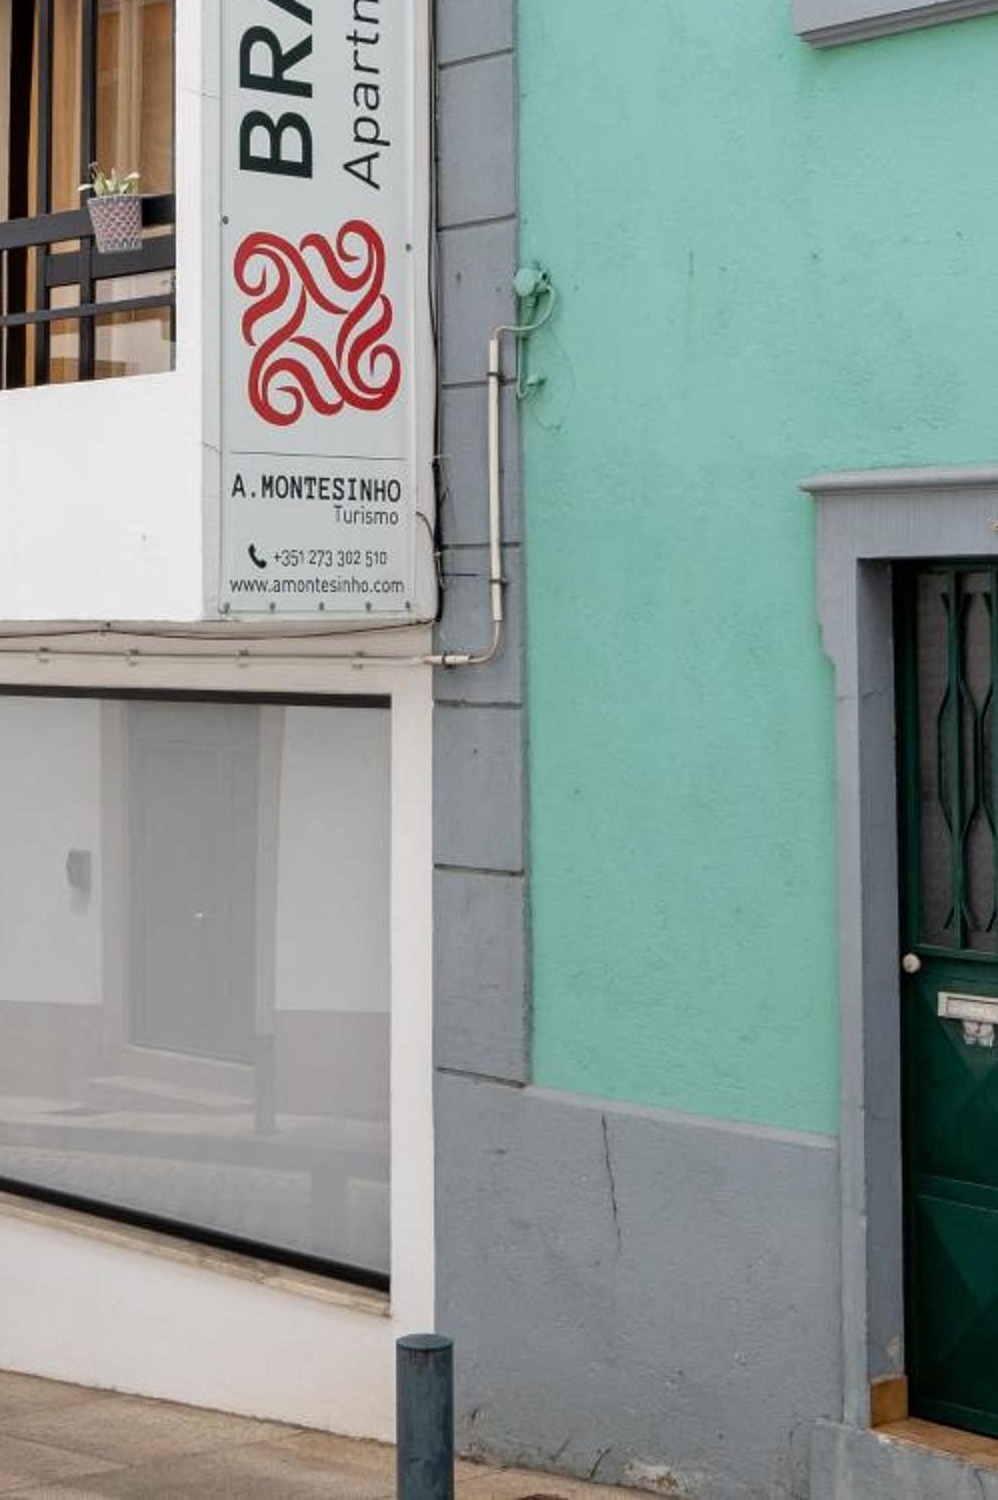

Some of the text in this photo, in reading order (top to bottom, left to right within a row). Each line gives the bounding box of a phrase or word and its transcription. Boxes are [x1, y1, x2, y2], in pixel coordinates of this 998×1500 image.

[333, 504, 399, 526] Turismo
[273, 549, 387, 568] +351 273 302 510
[229, 576, 404, 595] www.amontesinho.com
